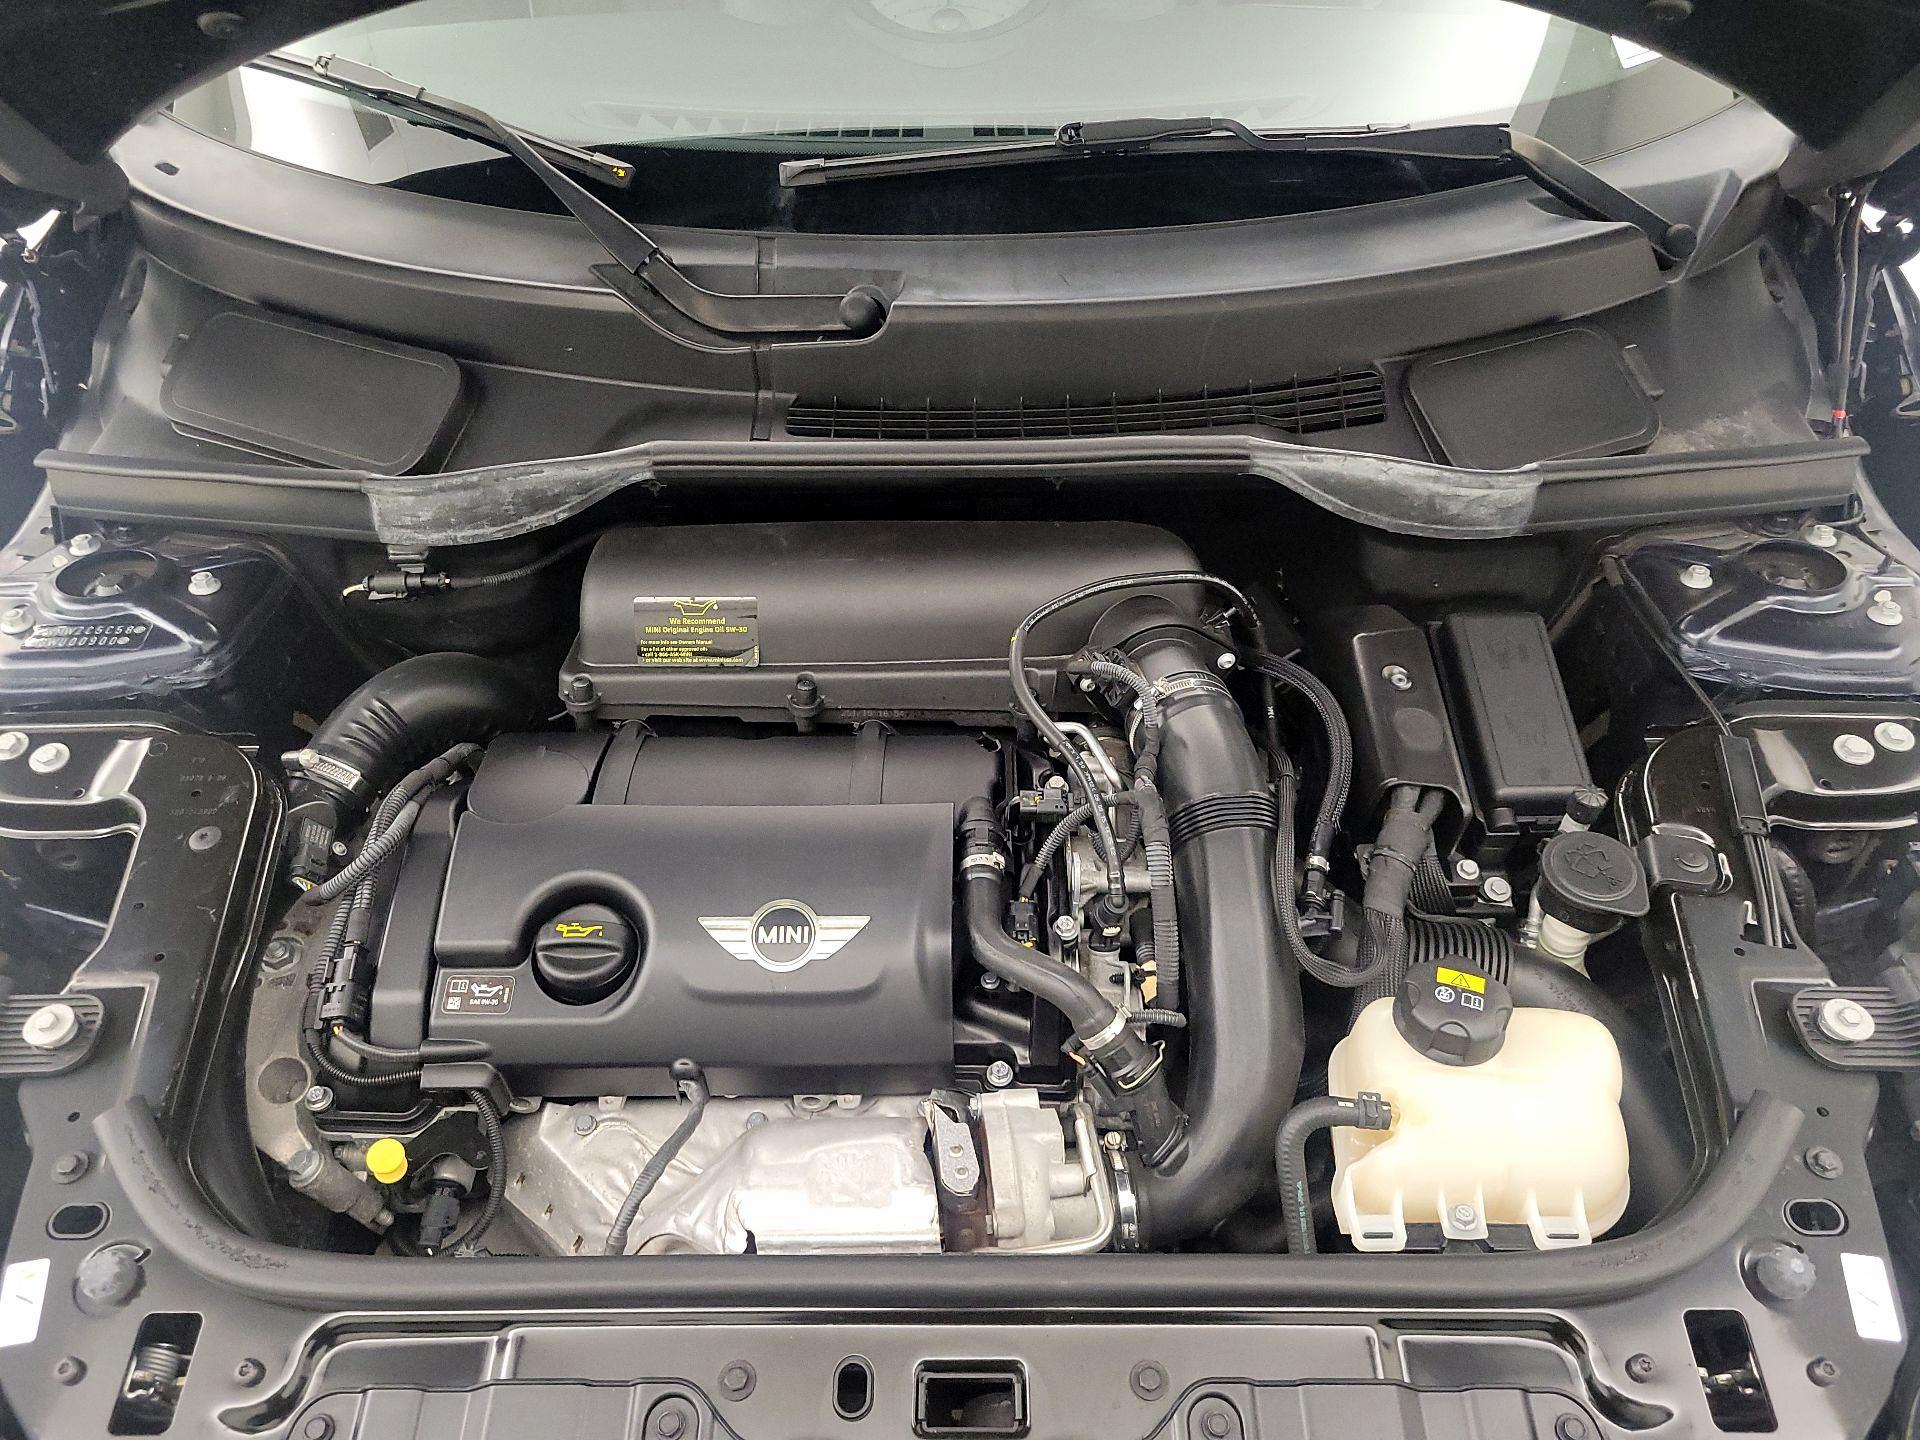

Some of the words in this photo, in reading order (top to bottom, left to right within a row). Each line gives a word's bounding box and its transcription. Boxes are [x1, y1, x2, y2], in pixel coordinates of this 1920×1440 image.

[645, 626, 661, 634] MINI
[662, 626, 689, 635] Original
[690, 626, 713, 635] Engine
[758, 926, 809, 944] MINI
